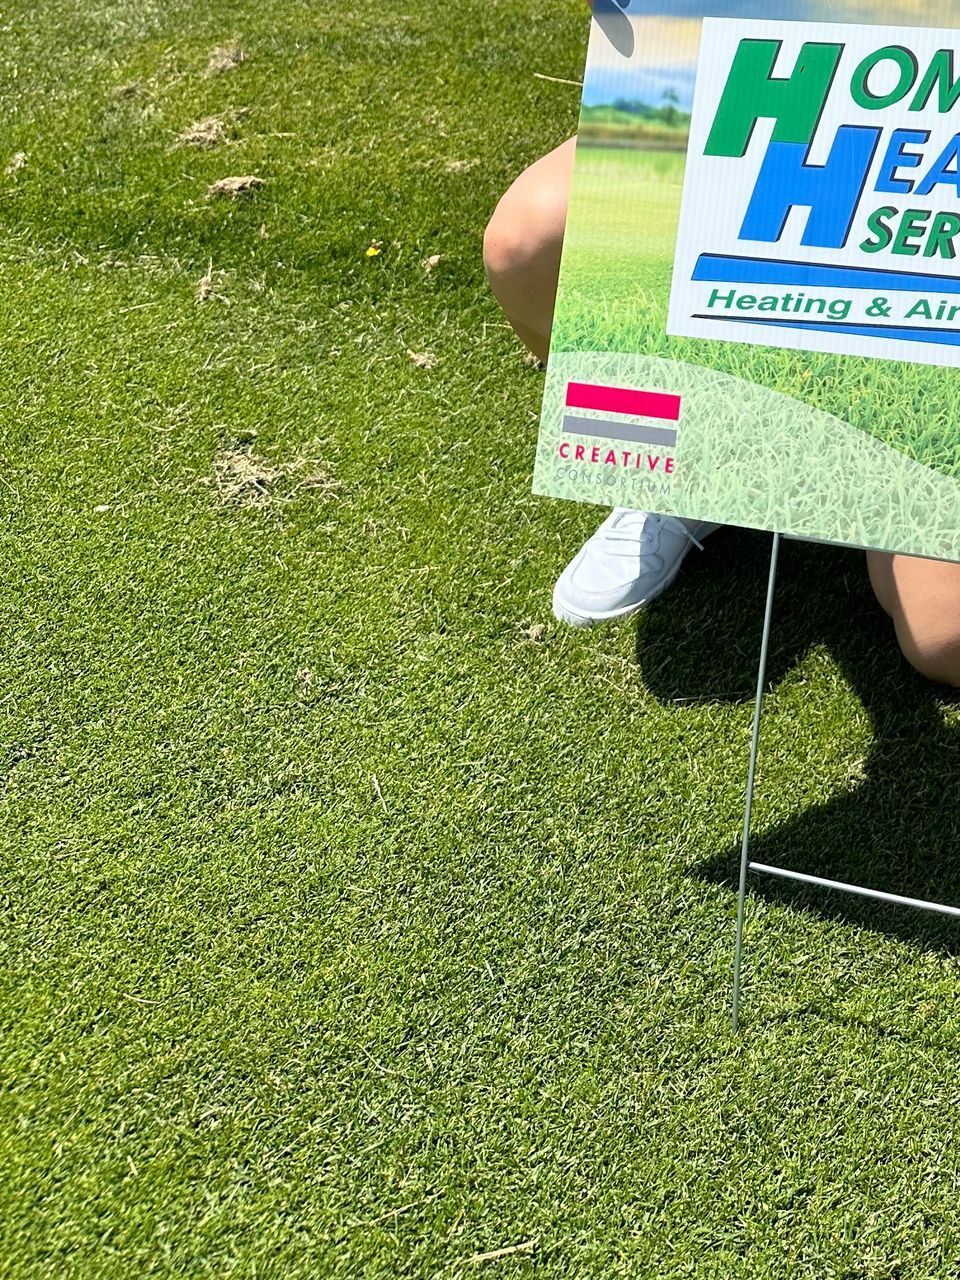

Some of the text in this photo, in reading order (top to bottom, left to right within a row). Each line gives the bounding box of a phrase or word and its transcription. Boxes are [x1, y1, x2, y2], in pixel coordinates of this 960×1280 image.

[707, 288, 852, 320] Heating
[865, 296, 892, 319] &
[559, 443, 674, 473] CREATIVE
[556, 468, 671, 495] CONSORTIUM
